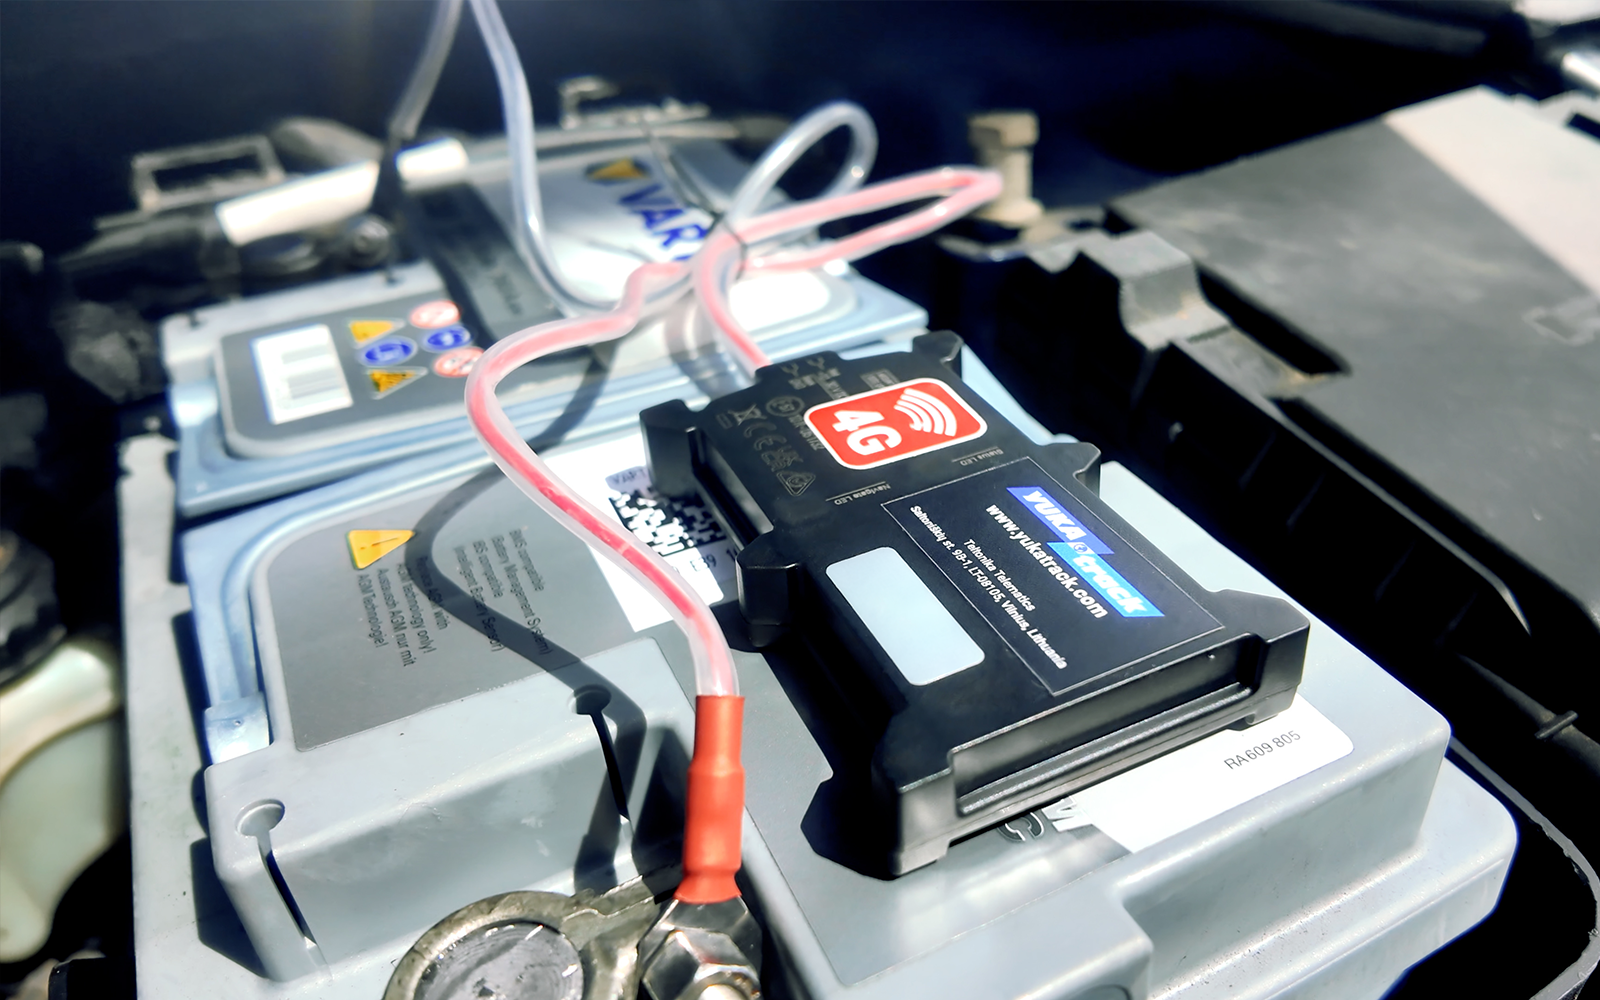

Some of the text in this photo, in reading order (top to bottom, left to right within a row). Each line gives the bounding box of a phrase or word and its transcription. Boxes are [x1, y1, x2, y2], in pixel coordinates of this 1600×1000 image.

[620, 182, 712, 263] VAR
[832, 409, 903, 456] 4G
[959, 457, 978, 467] LED
[834, 483, 892, 506] Navigate LED
[1022, 490, 1087, 541] YUKA
[963, 538, 1036, 612] Teltonika Telematics
[985, 504, 1109, 619] www.yukatrack.com
[356, 573, 375, 595] AGM
[1072, 555, 1148, 614] track
[388, 610, 408, 633] AGM
[433, 608, 451, 631] with
[503, 562, 536, 619] Management
[527, 616, 555, 655] System)
[951, 549, 973, 569] 9B-1,
[967, 566, 1006, 603] LT-08105,
[1001, 600, 1030, 631] Vilnius,
[1026, 628, 1068, 669] Lithuania
[395, 632, 410, 649] nur
[417, 628, 437, 654] only!
[482, 615, 507, 653] Sensor)
[400, 648, 418, 668] mit
[1271, 729, 1301, 748] 805
